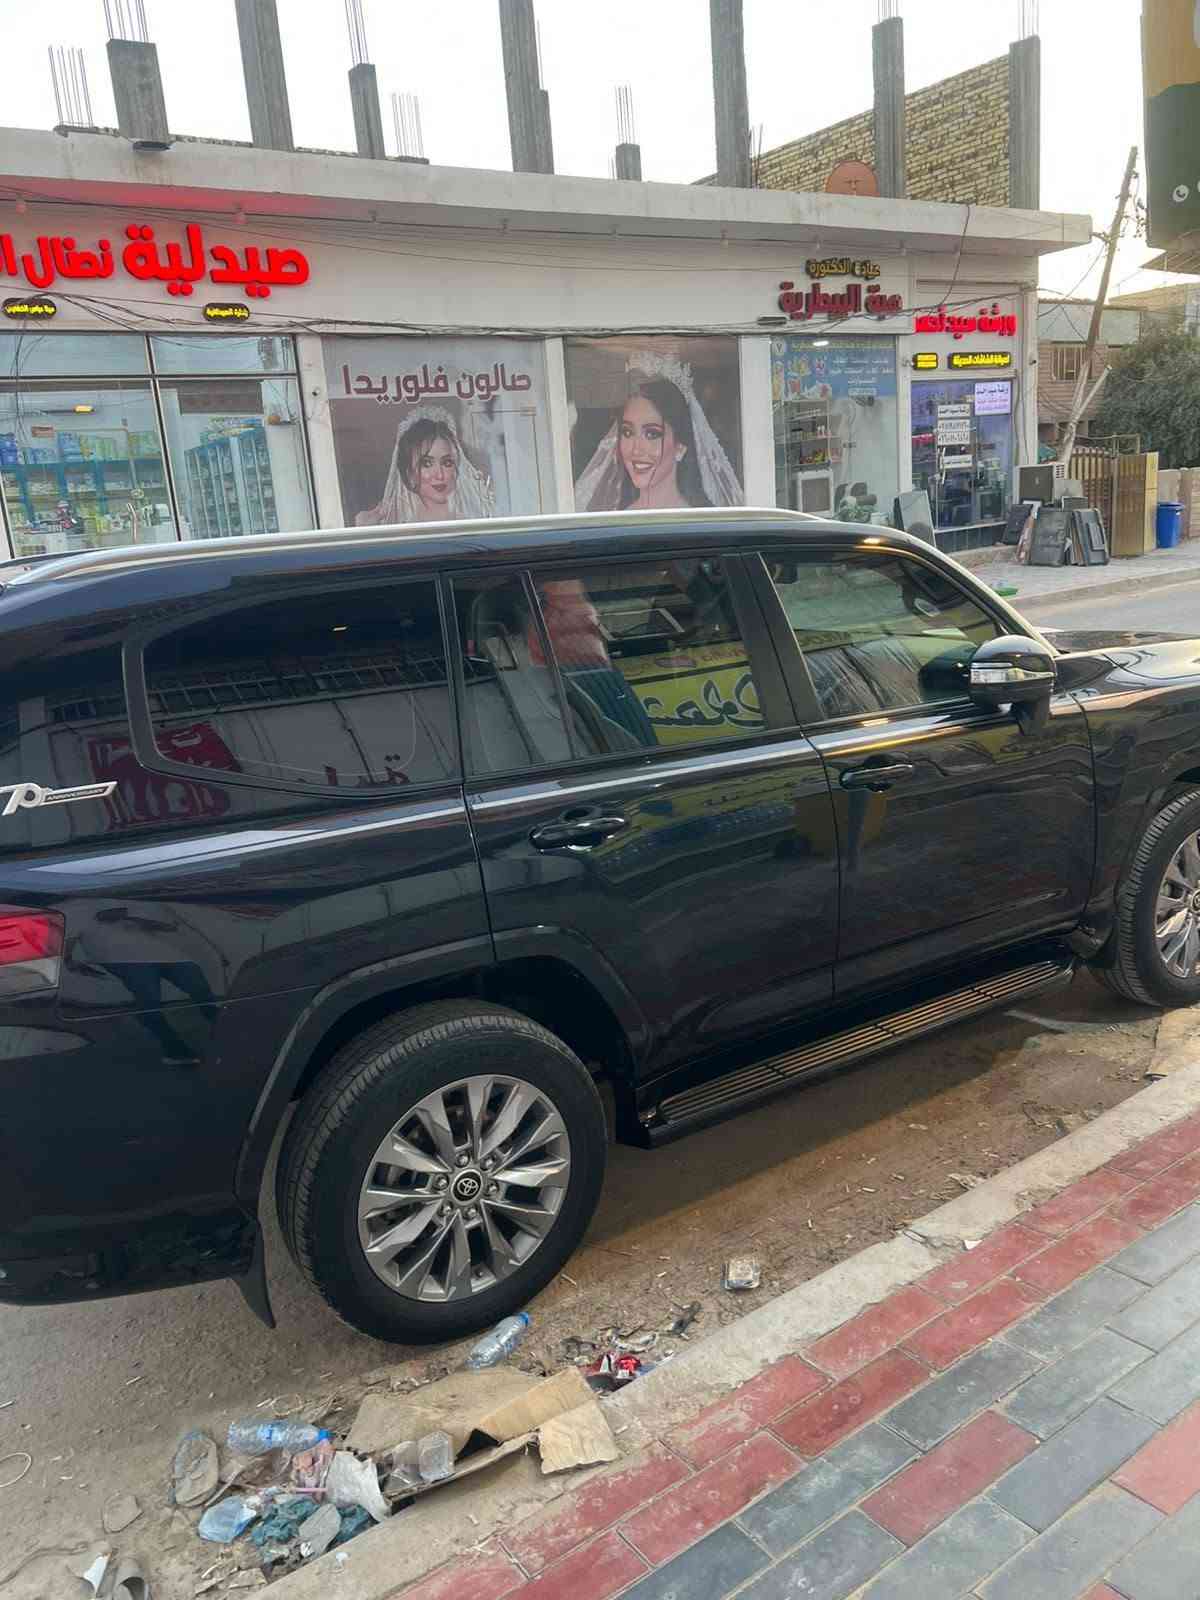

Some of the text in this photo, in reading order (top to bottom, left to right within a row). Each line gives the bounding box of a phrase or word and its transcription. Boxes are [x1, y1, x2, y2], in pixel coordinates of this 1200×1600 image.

[21, 235, 115, 288] نضال
[122, 223, 310, 298] صيدلية
[805, 257, 851, 279] الدكتورة
[778, 281, 862, 321] البيطرية
[977, 303, 1017, 336] ورشة
[341, 362, 532, 402] صالون فلوريدا
